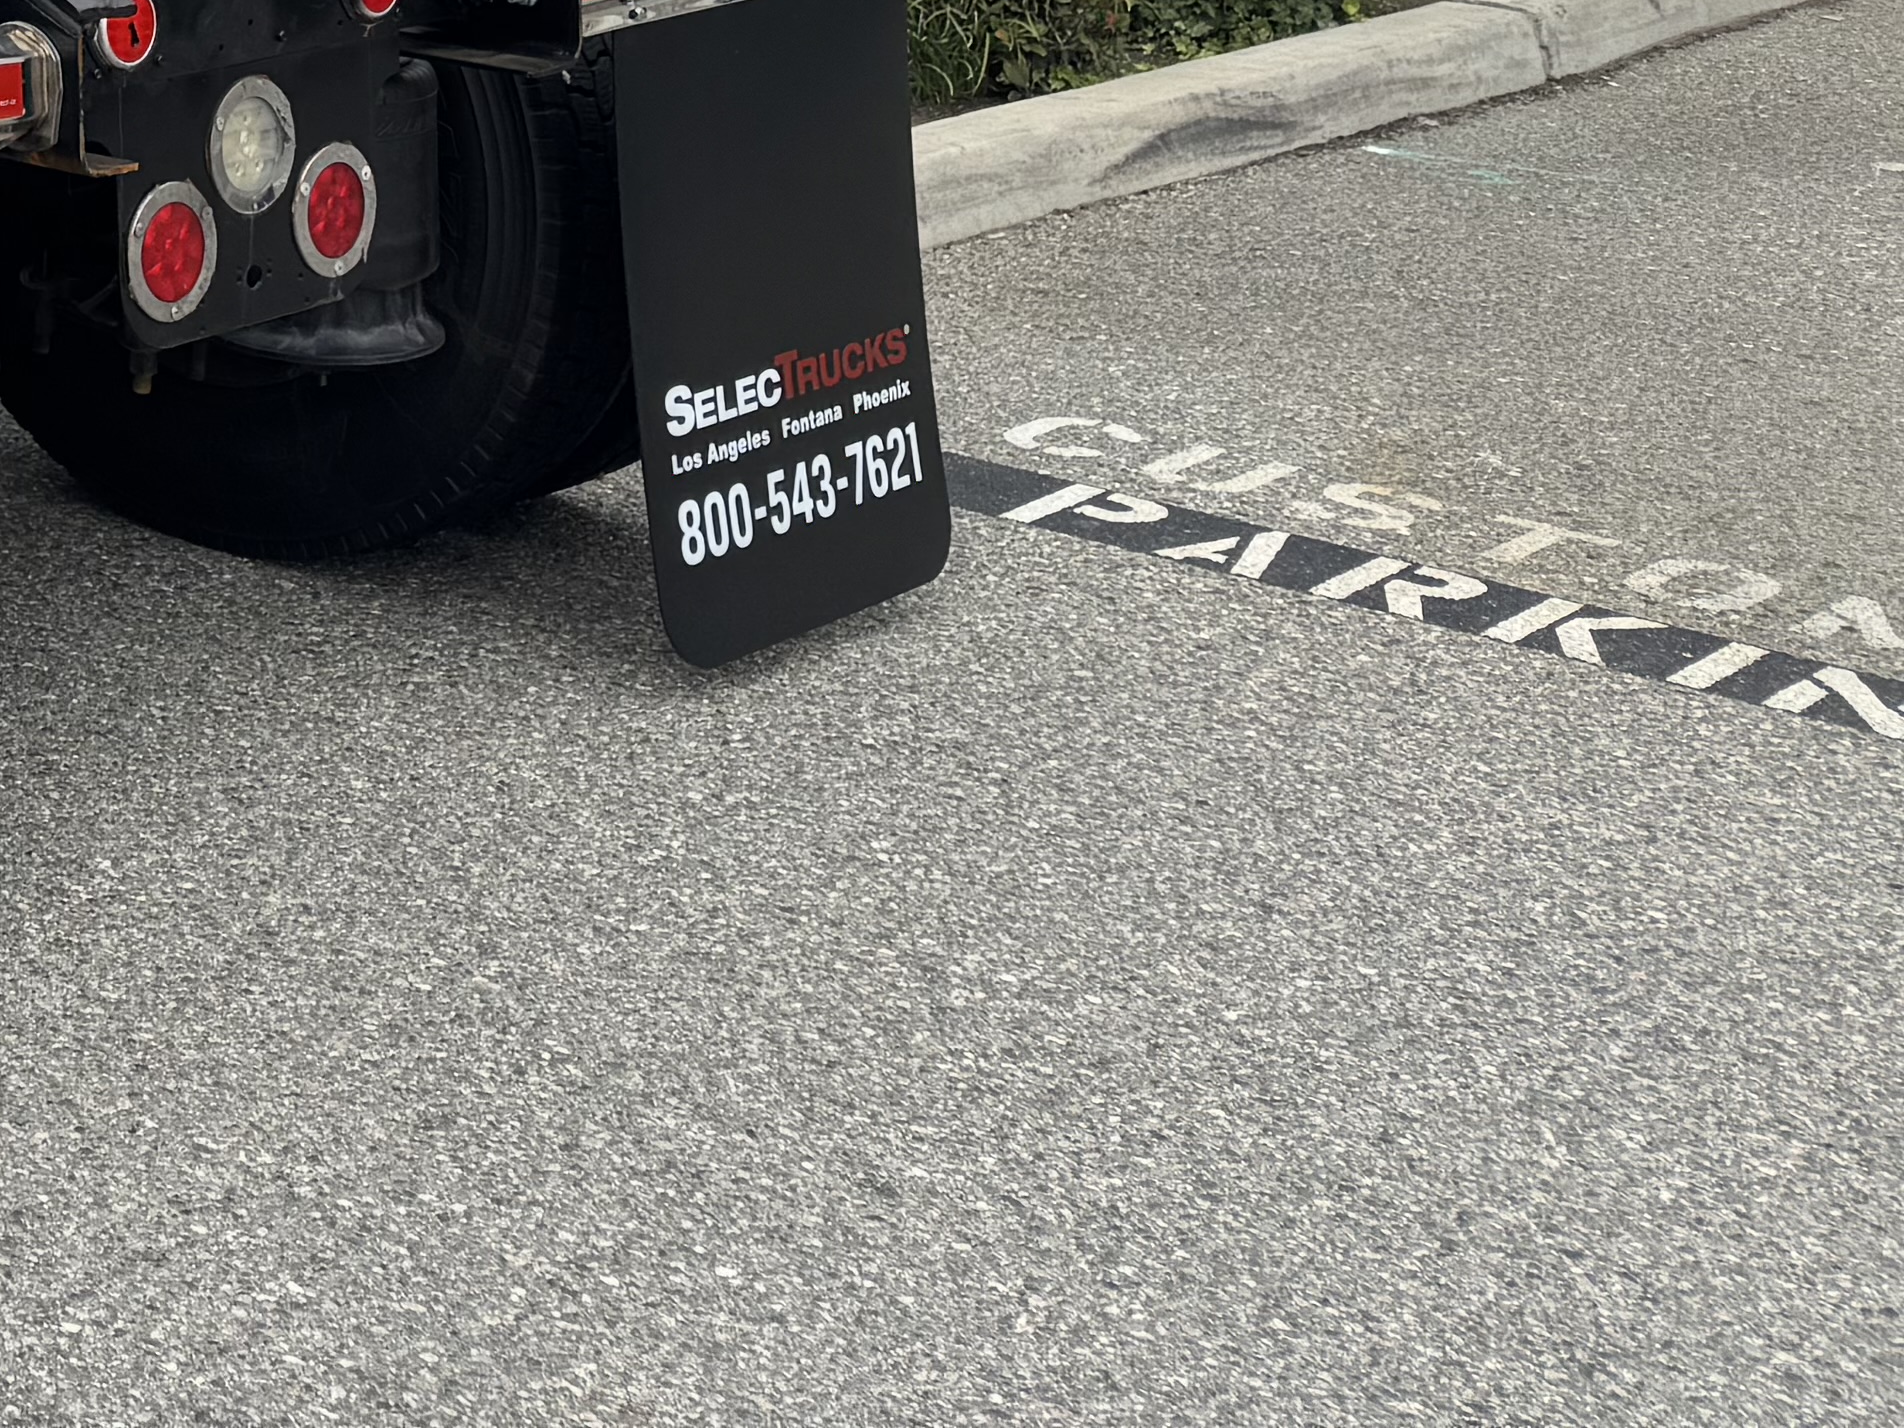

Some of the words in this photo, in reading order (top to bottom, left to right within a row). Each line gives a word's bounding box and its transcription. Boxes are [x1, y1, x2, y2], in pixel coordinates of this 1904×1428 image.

[664, 327, 908, 437] SELECTRUCKS
[671, 452, 703, 475] Los
[707, 428, 771, 465] Angeles
[781, 403, 844, 439] Fontana
[853, 378, 912, 415] Phoenix
[677, 421, 923, 566] 800-543-7621
